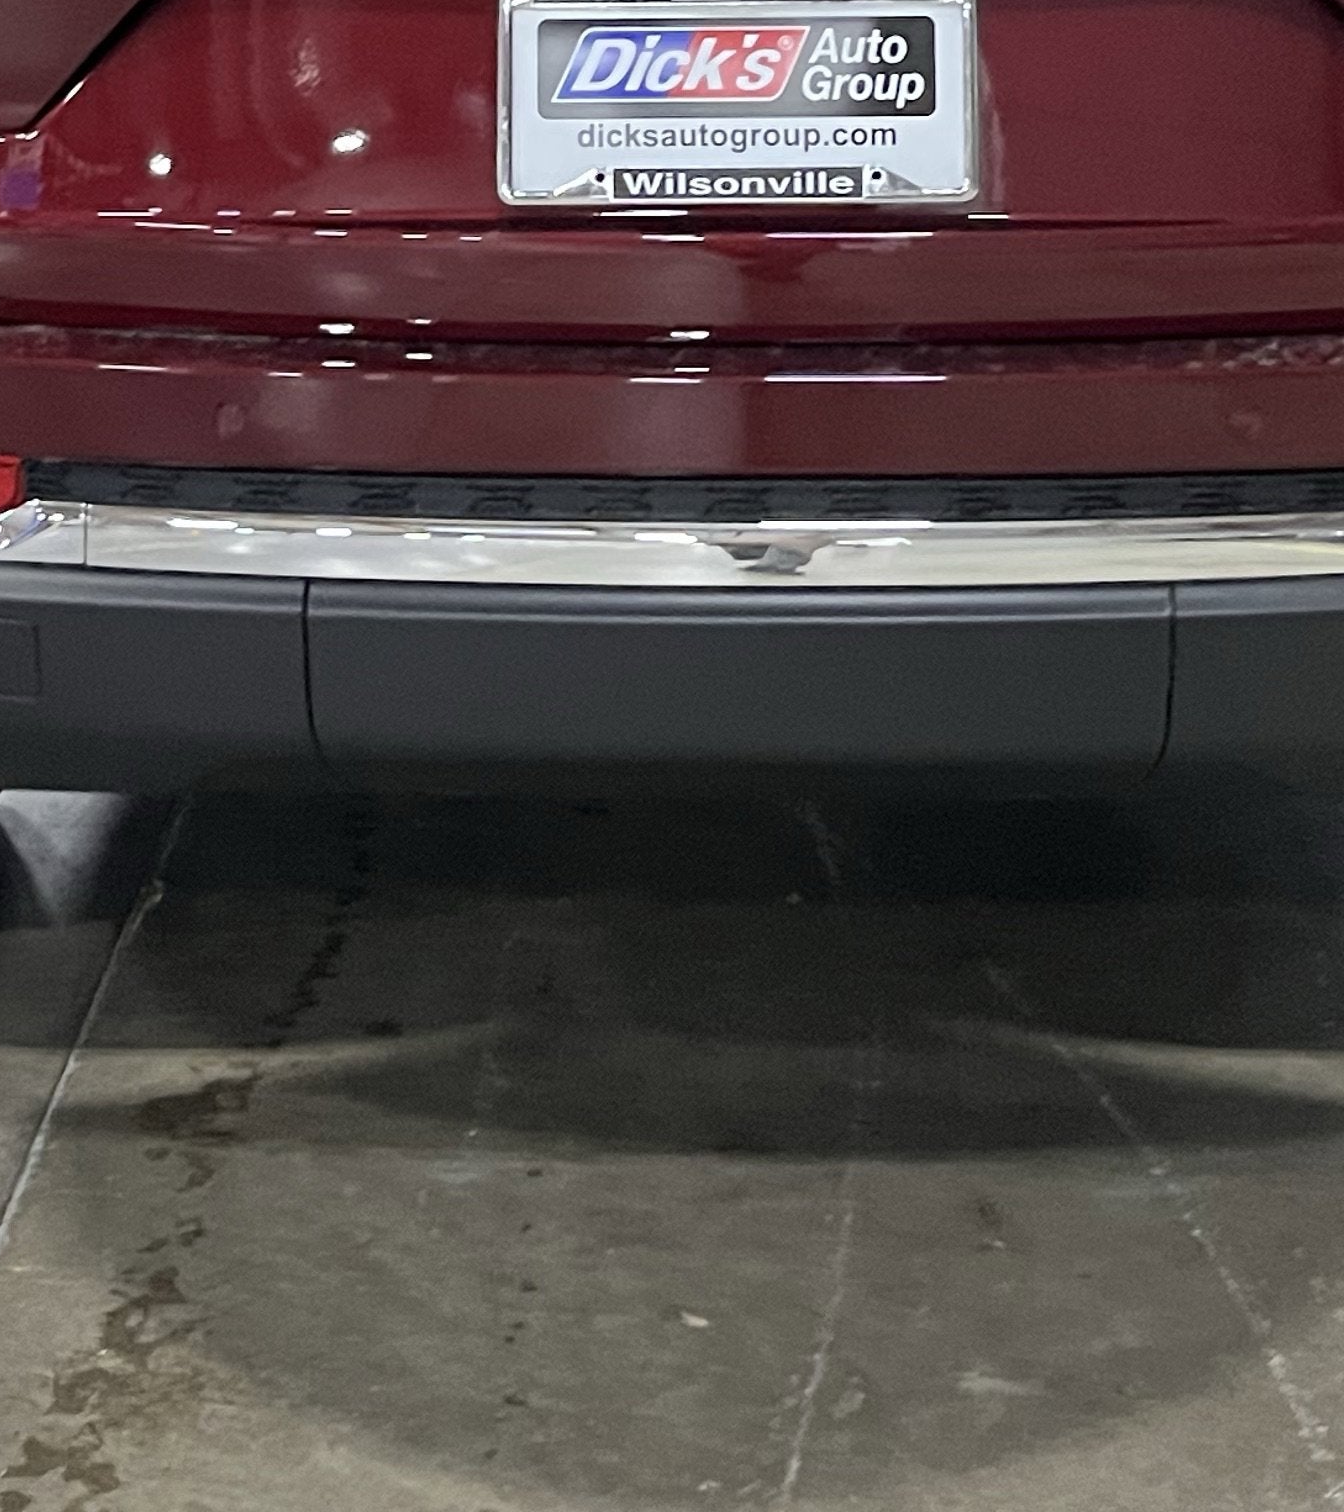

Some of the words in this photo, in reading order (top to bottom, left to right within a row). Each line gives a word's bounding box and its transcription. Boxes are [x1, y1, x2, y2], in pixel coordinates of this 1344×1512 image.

[570, 34, 782, 92] Dick's
[808, 27, 909, 65] Auto
[802, 66, 926, 109] Group
[577, 122, 898, 153] dicksautogroup.com
[622, 171, 856, 197] Wilsonville
